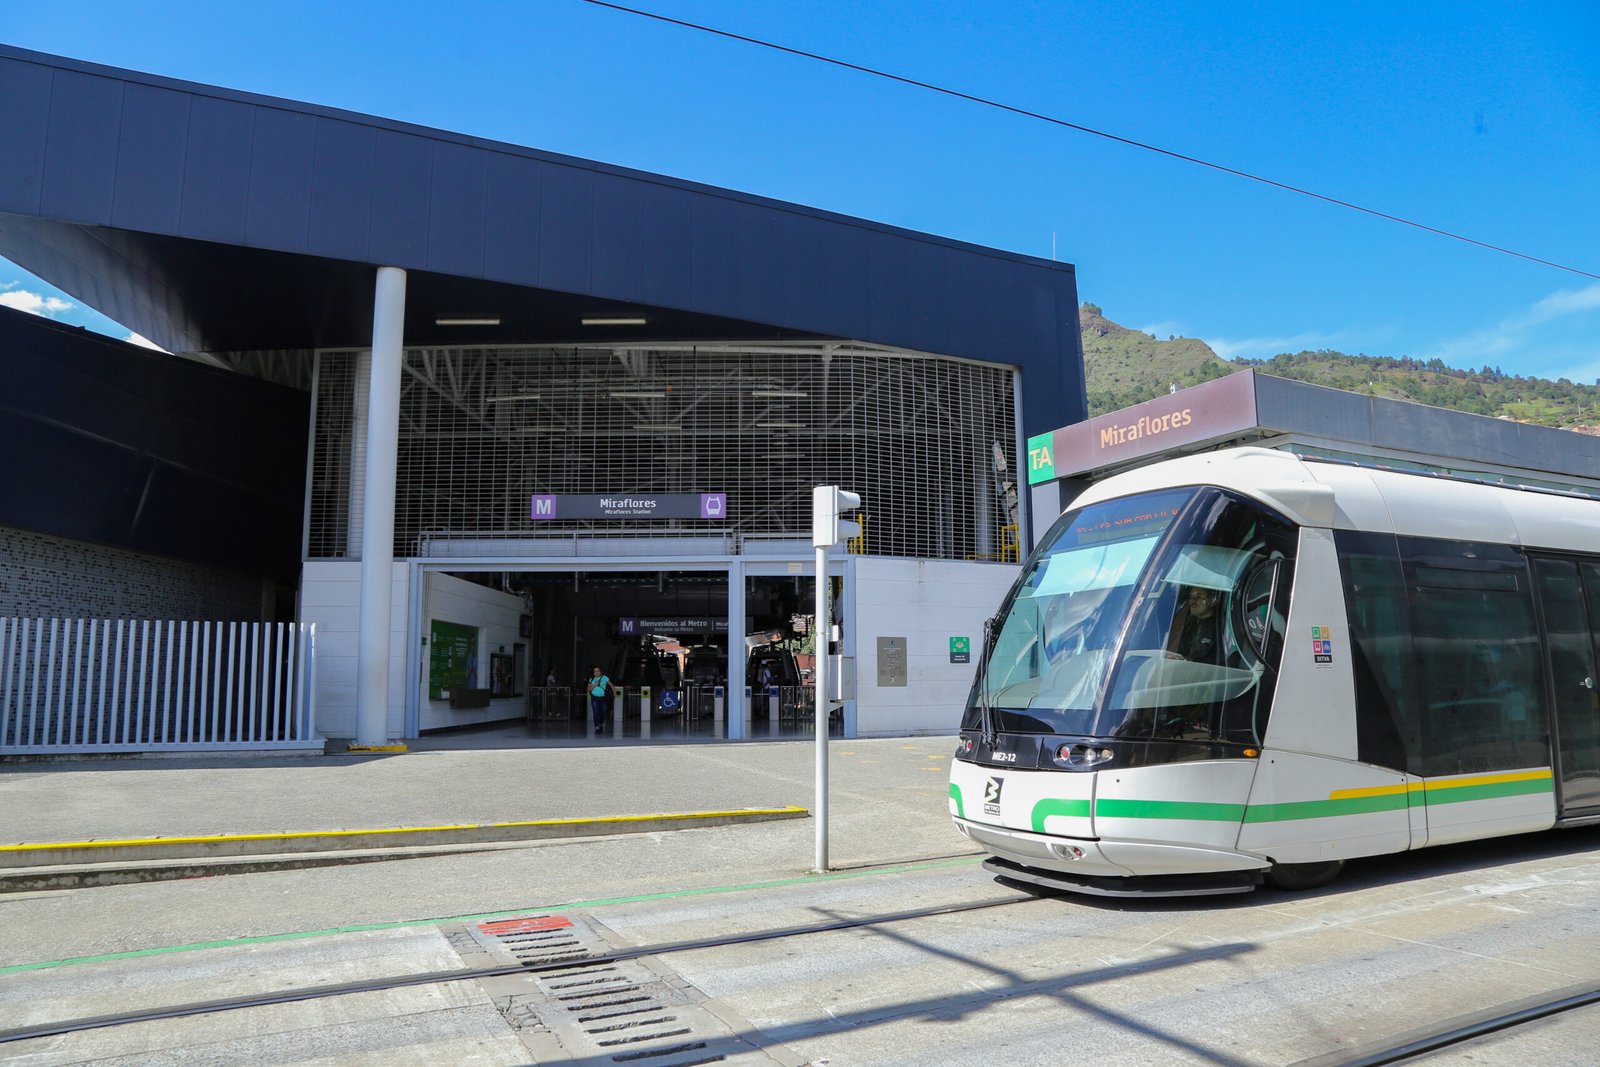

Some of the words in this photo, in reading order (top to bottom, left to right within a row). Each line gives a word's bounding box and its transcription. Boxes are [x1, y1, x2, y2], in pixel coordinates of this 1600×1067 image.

[1100, 408, 1192, 449] Miraflores
[536, 500, 551, 514] M
[600, 498, 657, 508] Miraflores
[622, 620, 633, 632] M
[992, 752, 1016, 762] ME2-12
